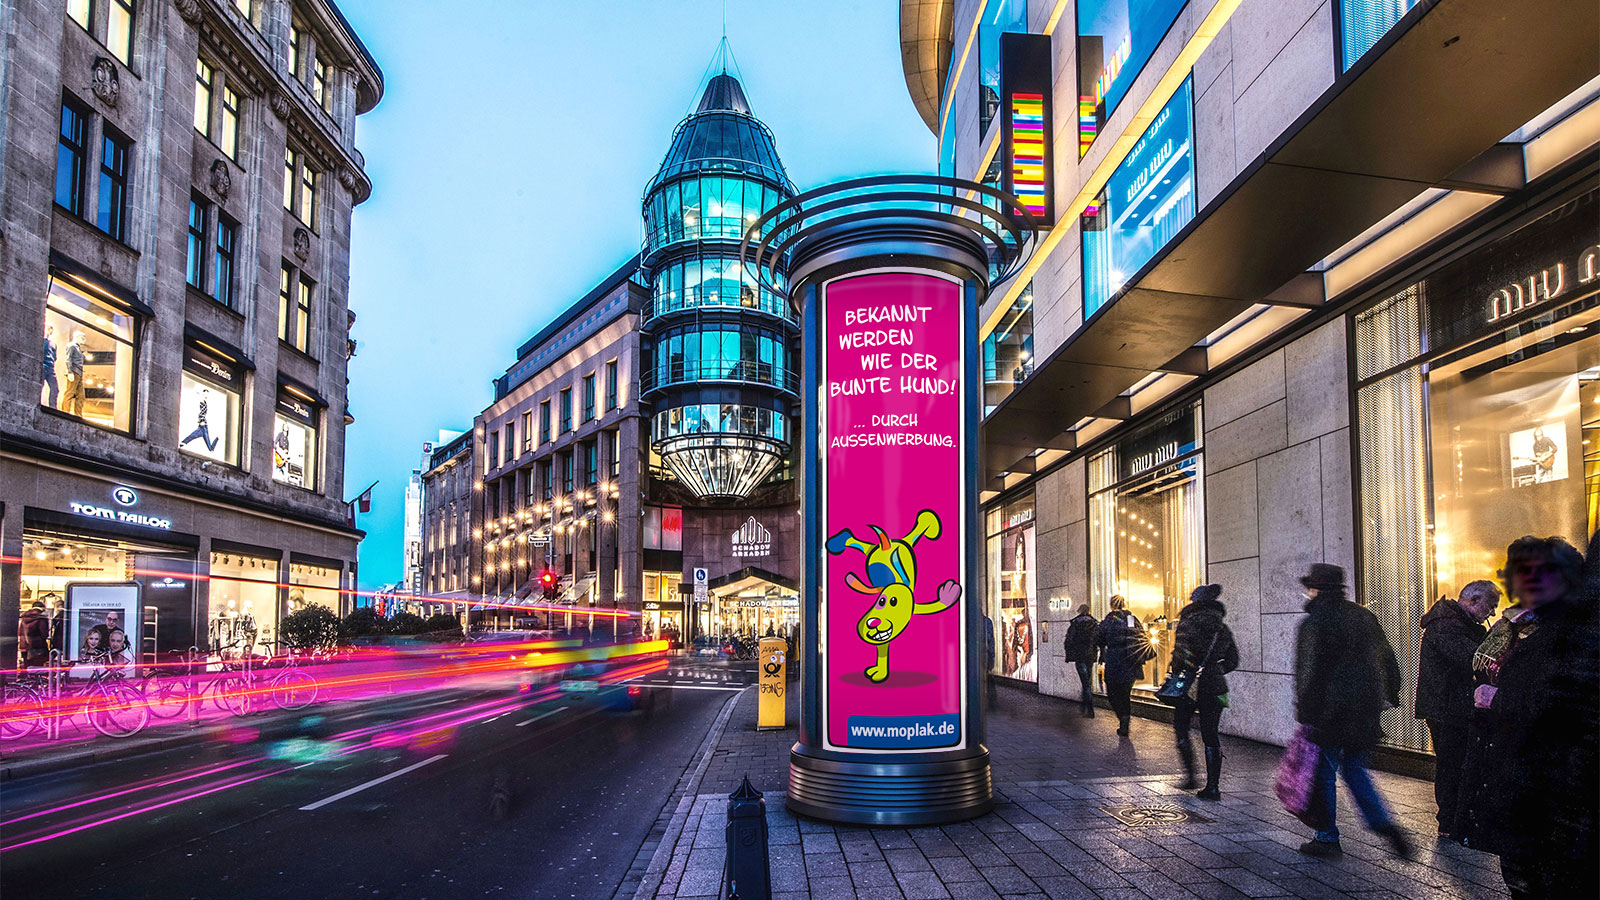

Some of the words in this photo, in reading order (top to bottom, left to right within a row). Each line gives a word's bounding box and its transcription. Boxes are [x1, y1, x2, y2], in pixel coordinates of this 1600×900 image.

[1487, 262, 1564, 322] miu
[845, 304, 932, 326] BEKANNT
[839, 328, 913, 350] WERDEN
[861, 353, 893, 371] WIE
[901, 353, 938, 371] DER
[830, 376, 892, 397] BUNTE
[900, 375, 957, 395] HUND!
[871, 413, 918, 427] DURCH
[831, 433, 957, 448] AUSSENWERBUNG.
[69, 502, 117, 520] TOM
[117, 511, 172, 530] TAILOR
[851, 721, 955, 740] www.moplak.de
